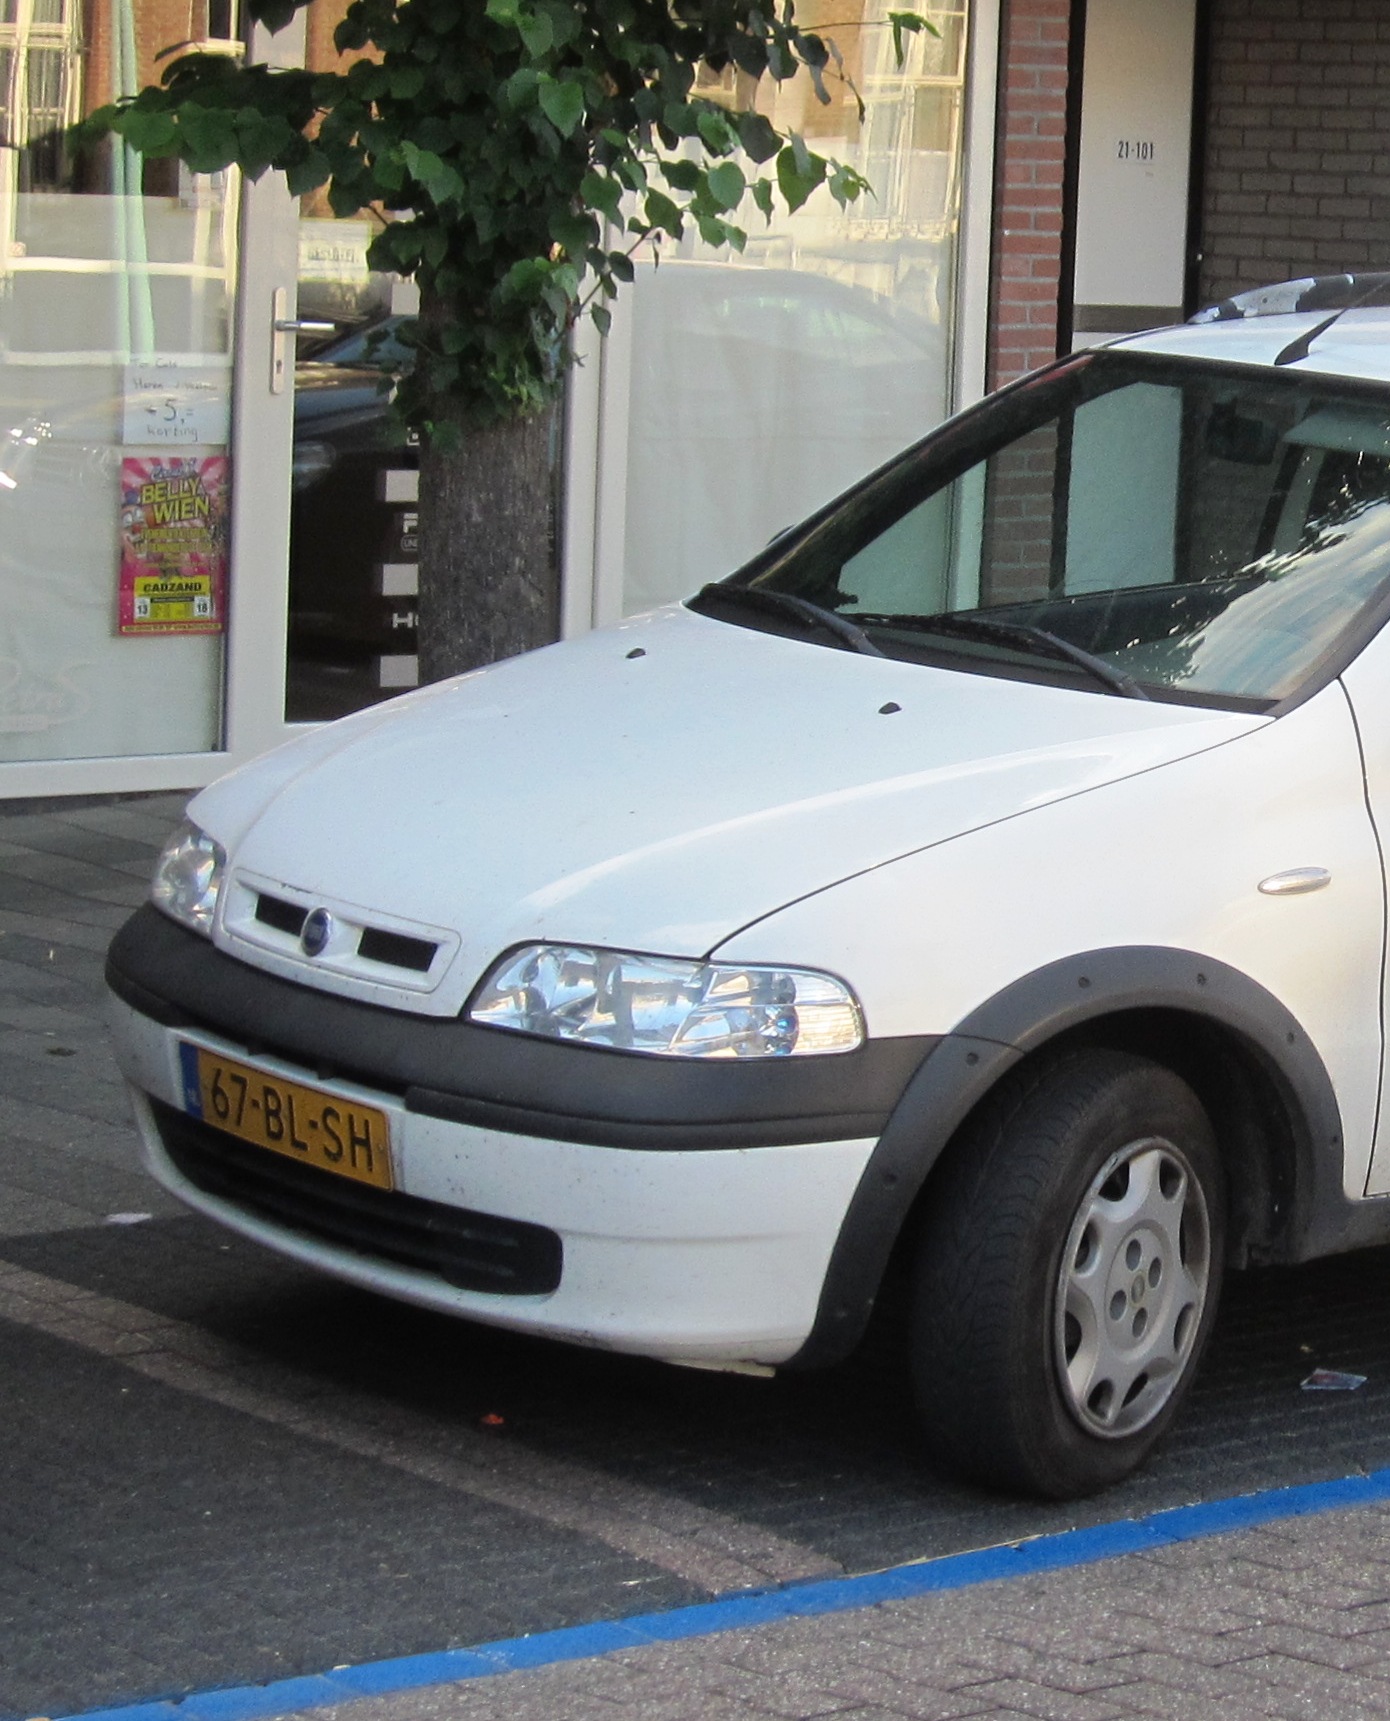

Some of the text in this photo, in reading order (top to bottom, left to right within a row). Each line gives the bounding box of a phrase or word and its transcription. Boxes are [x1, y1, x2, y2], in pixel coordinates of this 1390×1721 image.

[1117, 140, 1153, 160] 21-101
[142, 478, 200, 504] BELLY
[153, 495, 209, 524] WIEN
[143, 582, 202, 593] CADZAND
[211, 1067, 374, 1173] 67-BL-SH
